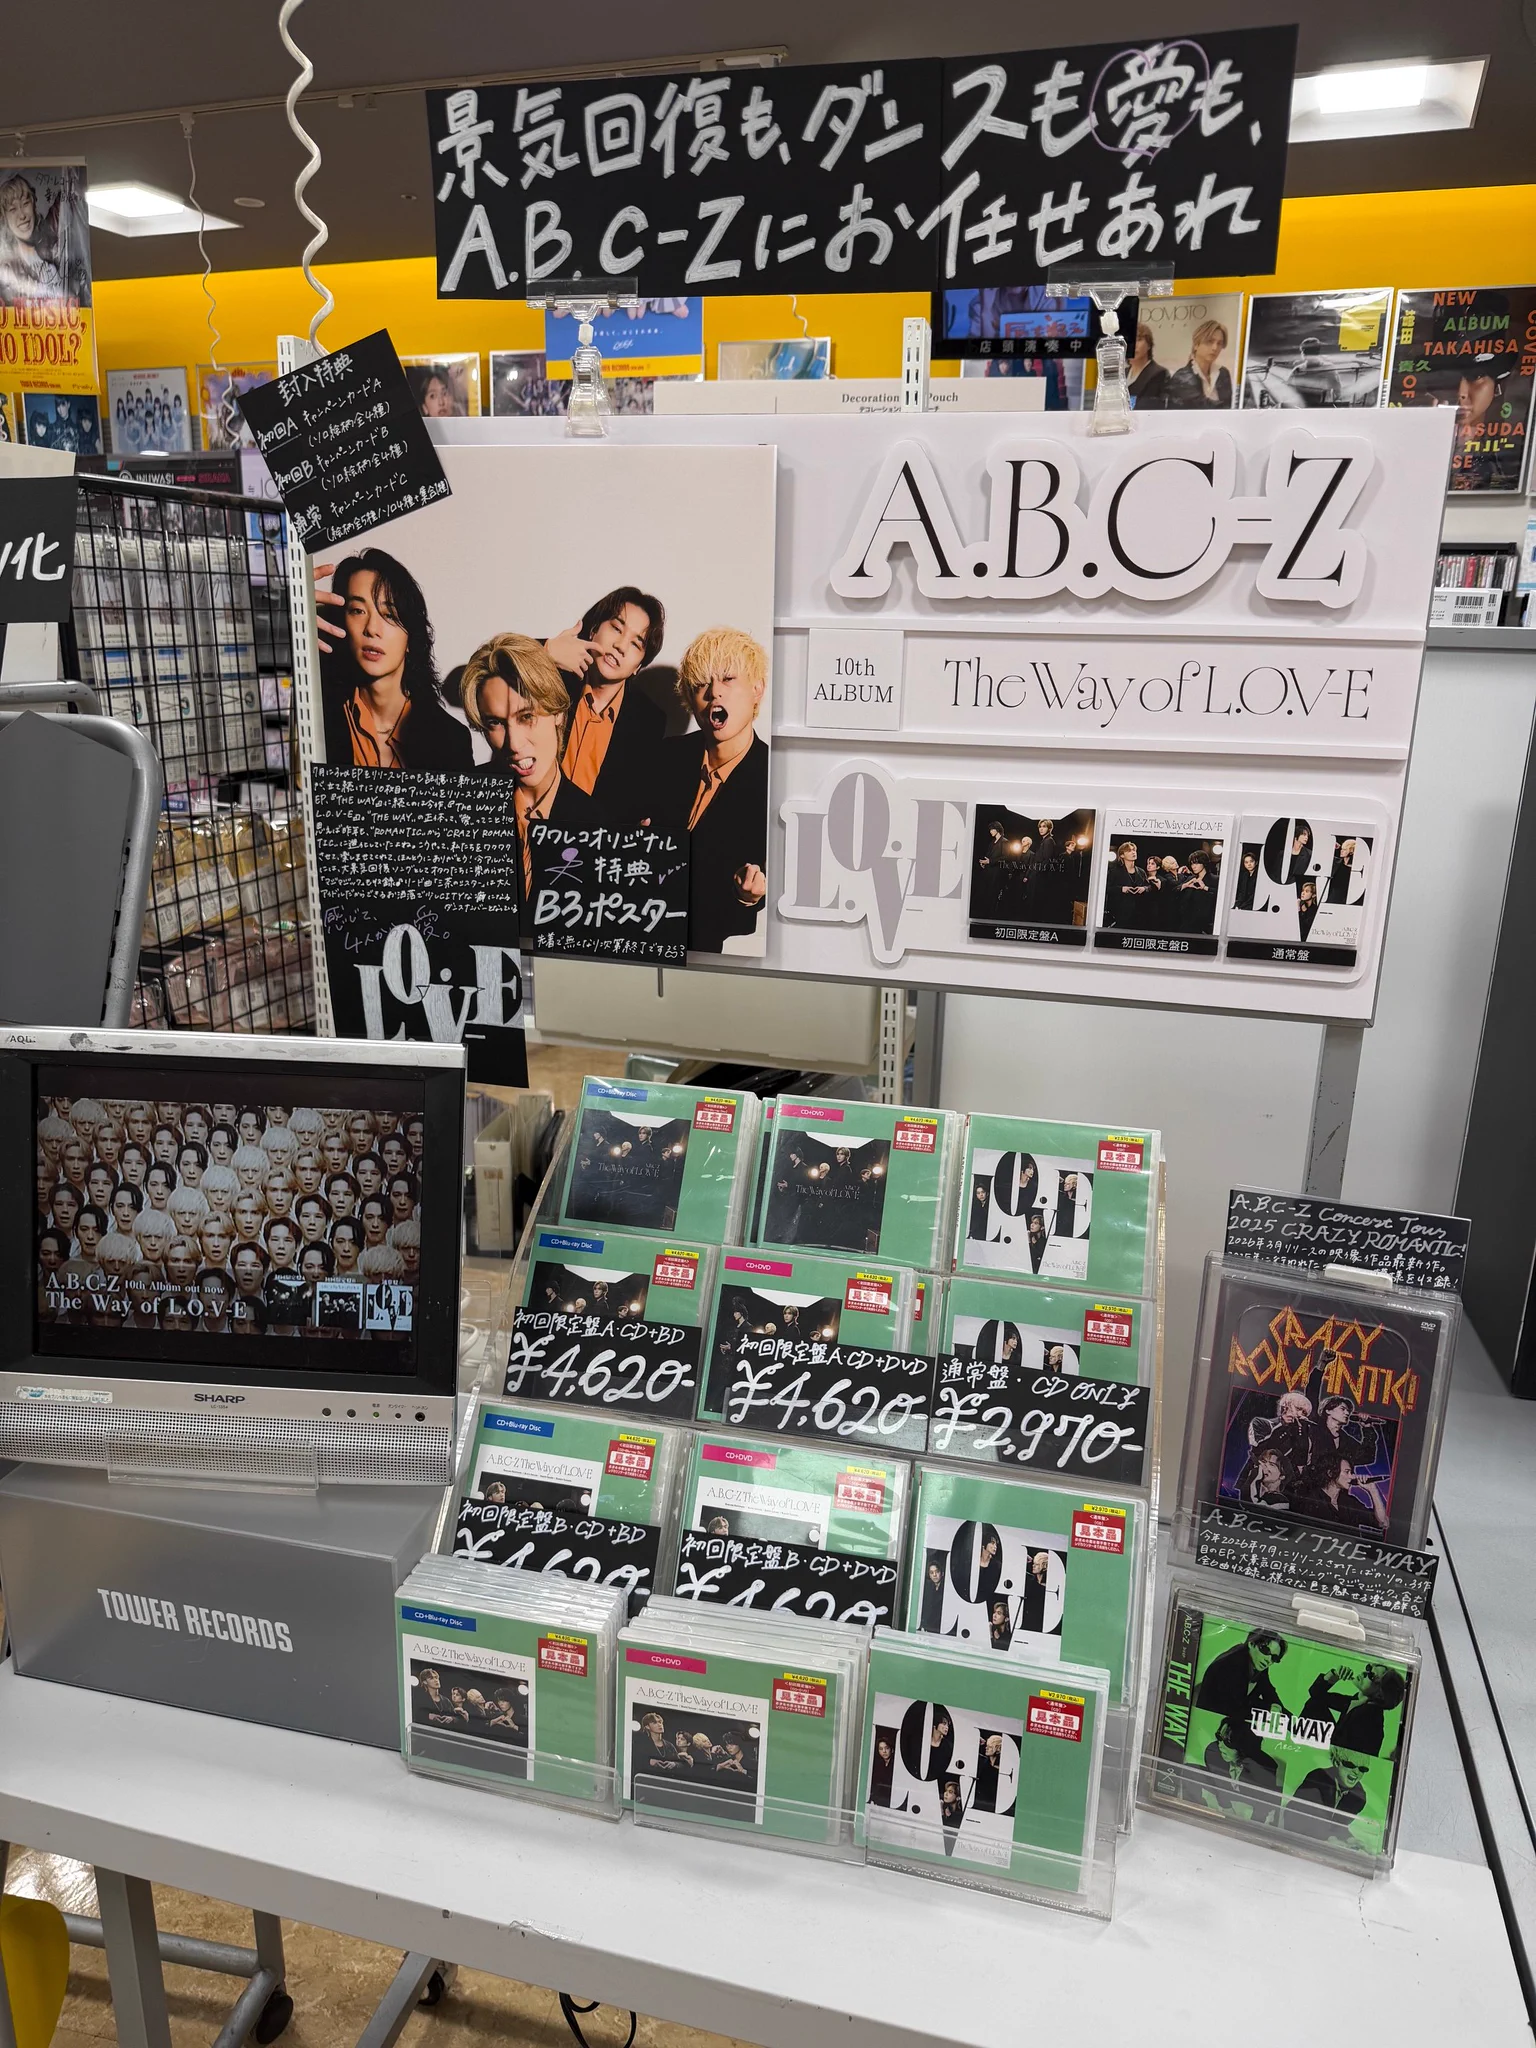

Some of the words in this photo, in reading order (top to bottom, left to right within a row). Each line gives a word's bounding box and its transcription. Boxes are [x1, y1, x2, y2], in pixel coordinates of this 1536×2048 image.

[441, 172, 1264, 293] A.B.C-Zにお任せあれ
[1433, 290, 1477, 306] NEW
[1140, 304, 1207, 322] DOMOTO
[1443, 315, 1510, 332] ALBUM
[1424, 339, 1519, 356] TAKAHISA
[1520, 309, 1536, 377] COVER
[278, 353, 354, 407] 封入特典
[1402, 375, 1417, 399] OF
[842, 393, 899, 403] Decoration
[257, 417, 298, 450] 初回A
[1455, 422, 1525, 436] ASUDA
[1464, 438, 1514, 453] カバー
[275, 460, 314, 491] 初回B
[293, 504, 322, 536] 通常
[849, 450, 1353, 586] A.B.C-Z
[834, 657, 876, 677] 10th
[813, 683, 894, 704] ALBUM
[944, 657, 1027, 709] The
[1029, 660, 1136, 728] Way
[1138, 659, 1202, 714] of
[1202, 665, 1374, 721] L.O.V-E
[532, 825, 677, 853] タワレコオリジナル
[595, 856, 653, 886] 特典
[534, 889, 688, 933] B3ポスター
[995, 927, 1059, 943] 初回限定盤A
[1121, 936, 1189, 952] 初回限定盤B
[1271, 947, 1309, 961] 通常盤
[800, 1107, 824, 1117] CD+DVD
[1230, 1193, 1312, 1218] A.B.C-Z
[1319, 1207, 1393, 1229] Concert
[1228, 1215, 1278, 1232] 2025
[1281, 1223, 1361, 1247] CRAZY
[746, 1261, 772, 1272] CD+DVD
[45, 1272, 120, 1292] A.B.C-Z
[125, 1280, 146, 1291] 10th
[150, 1280, 181, 1293] Album
[185, 1284, 200, 1293] out
[204, 1286, 225, 1294] now
[45, 1291, 82, 1310] The
[91, 1294, 133, 1318] Way
[140, 1298, 160, 1314] of
[168, 1298, 248, 1319] L.O.V-E
[1268, 1304, 1385, 1362] CRAZY
[1420, 1321, 1437, 1329] DVD
[194, 1393, 245, 1404] SHARP
[496, 1419, 528, 1431] CD+Blu-ray
[528, 1423, 542, 1432] Disc
[726, 1451, 753, 1462] CD+DVD
[1080, 1525, 1117, 1540] 見本品
[1202, 1508, 1290, 1542] A.B.C-Z
[1311, 1533, 1373, 1562] THE
[1373, 1549, 1437, 1577] WAY
[97, 1588, 180, 1631] TOWER
[183, 1604, 294, 1653] RECORDS
[414, 1611, 448, 1624] CD+Blu-ray
[449, 1617, 463, 1627] Disc
[413, 1642, 448, 1659] A.B.C-Z
[448, 1648, 466, 1662] The
[465, 1652, 484, 1667] Way
[651, 1656, 681, 1666] CD+DVD
[1167, 1661, 1192, 1700] THE
[636, 1686, 674, 1701] A.B.C-Z
[674, 1692, 692, 1704] The
[692, 1694, 713, 1709] Way
[1036, 1710, 1074, 1728] 見本品
[1164, 1703, 1190, 1748] WAY
[1251, 1708, 1289, 1739] THE
[1290, 1715, 1335, 1750] WAY
